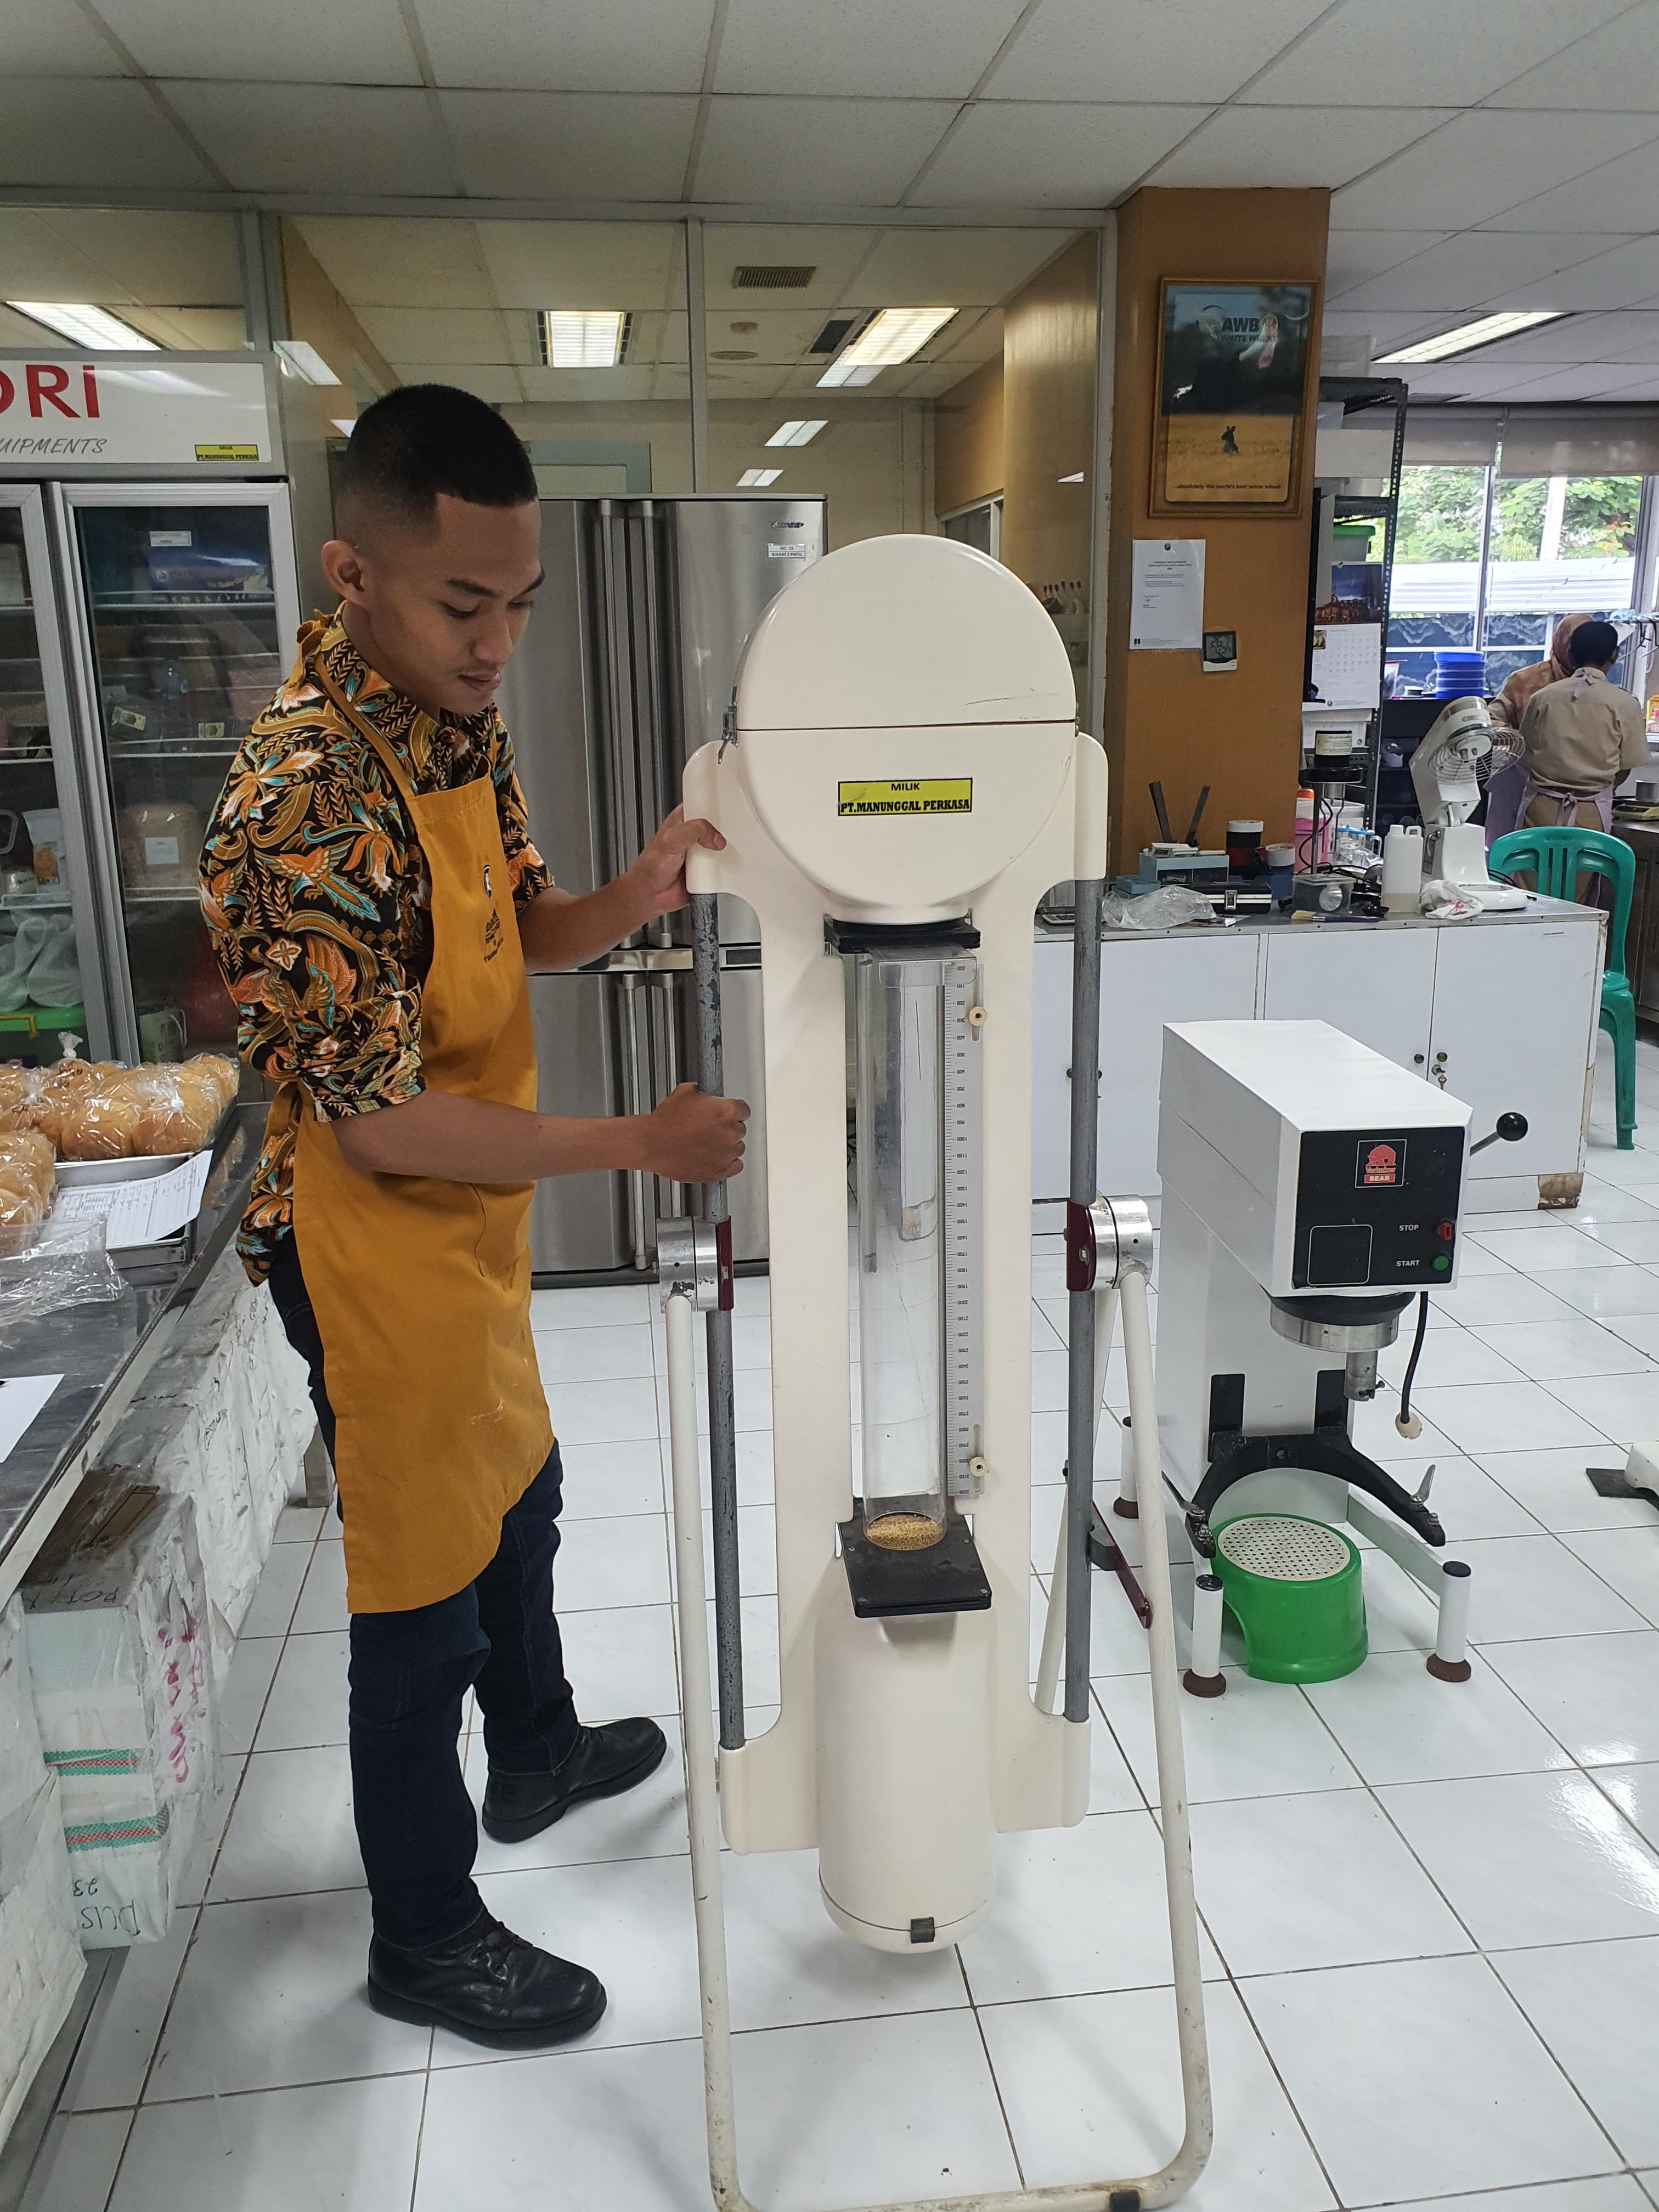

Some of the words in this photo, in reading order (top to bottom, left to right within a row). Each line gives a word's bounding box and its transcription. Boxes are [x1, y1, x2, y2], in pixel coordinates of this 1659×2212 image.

[1222, 318, 1260, 332] AWB
[840, 801, 921, 812] PT.MANUNGGAL
[923, 799, 970, 810] PERKASA
